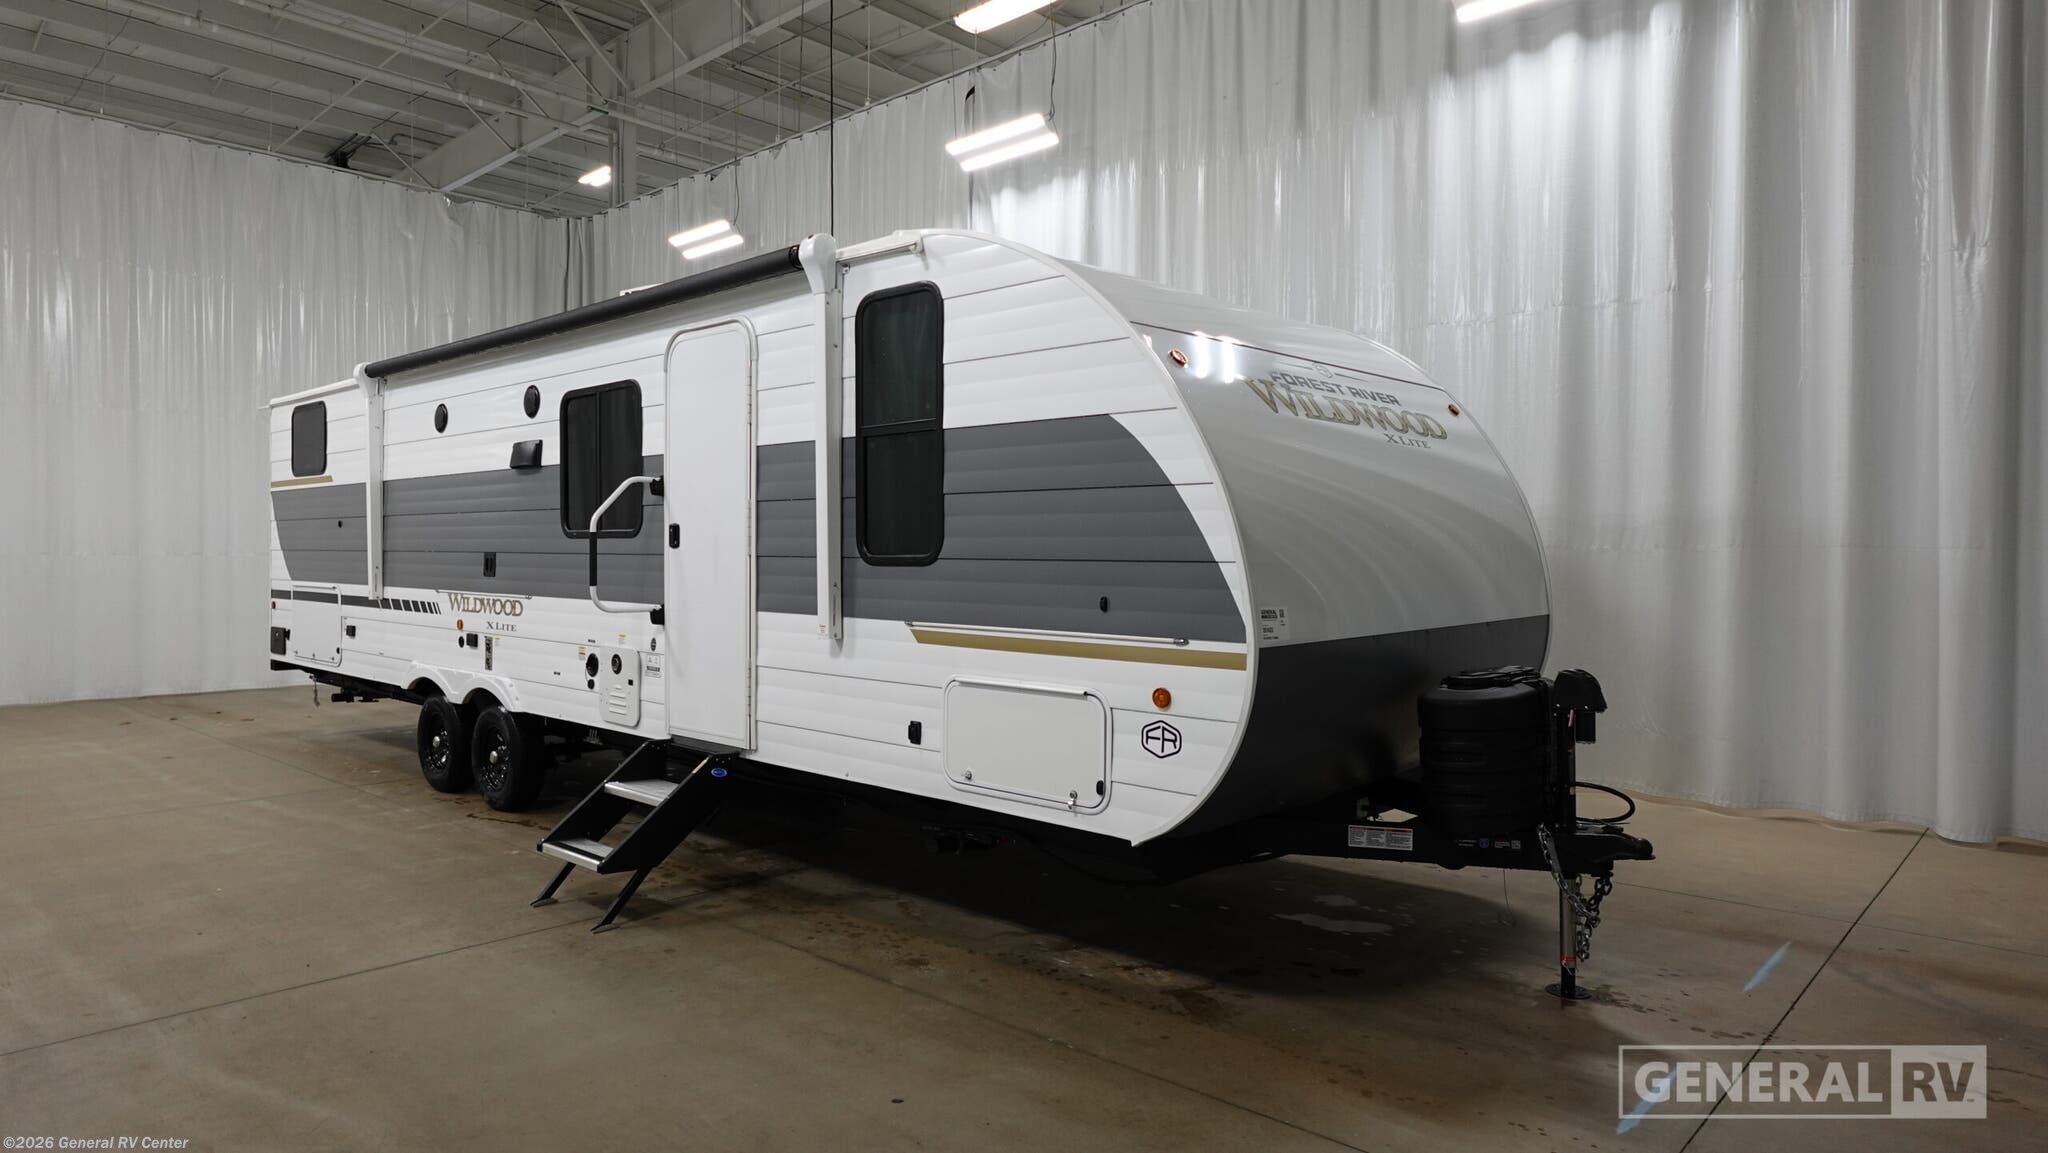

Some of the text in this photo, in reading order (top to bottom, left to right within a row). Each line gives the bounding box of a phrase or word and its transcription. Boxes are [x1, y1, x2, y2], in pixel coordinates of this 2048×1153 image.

[1270, 371, 1344, 395] FOREST
[1350, 385, 1401, 406] RIVER
[1245, 377, 1448, 440] WILDWOOD
[447, 592, 523, 616] WILDWOOD
